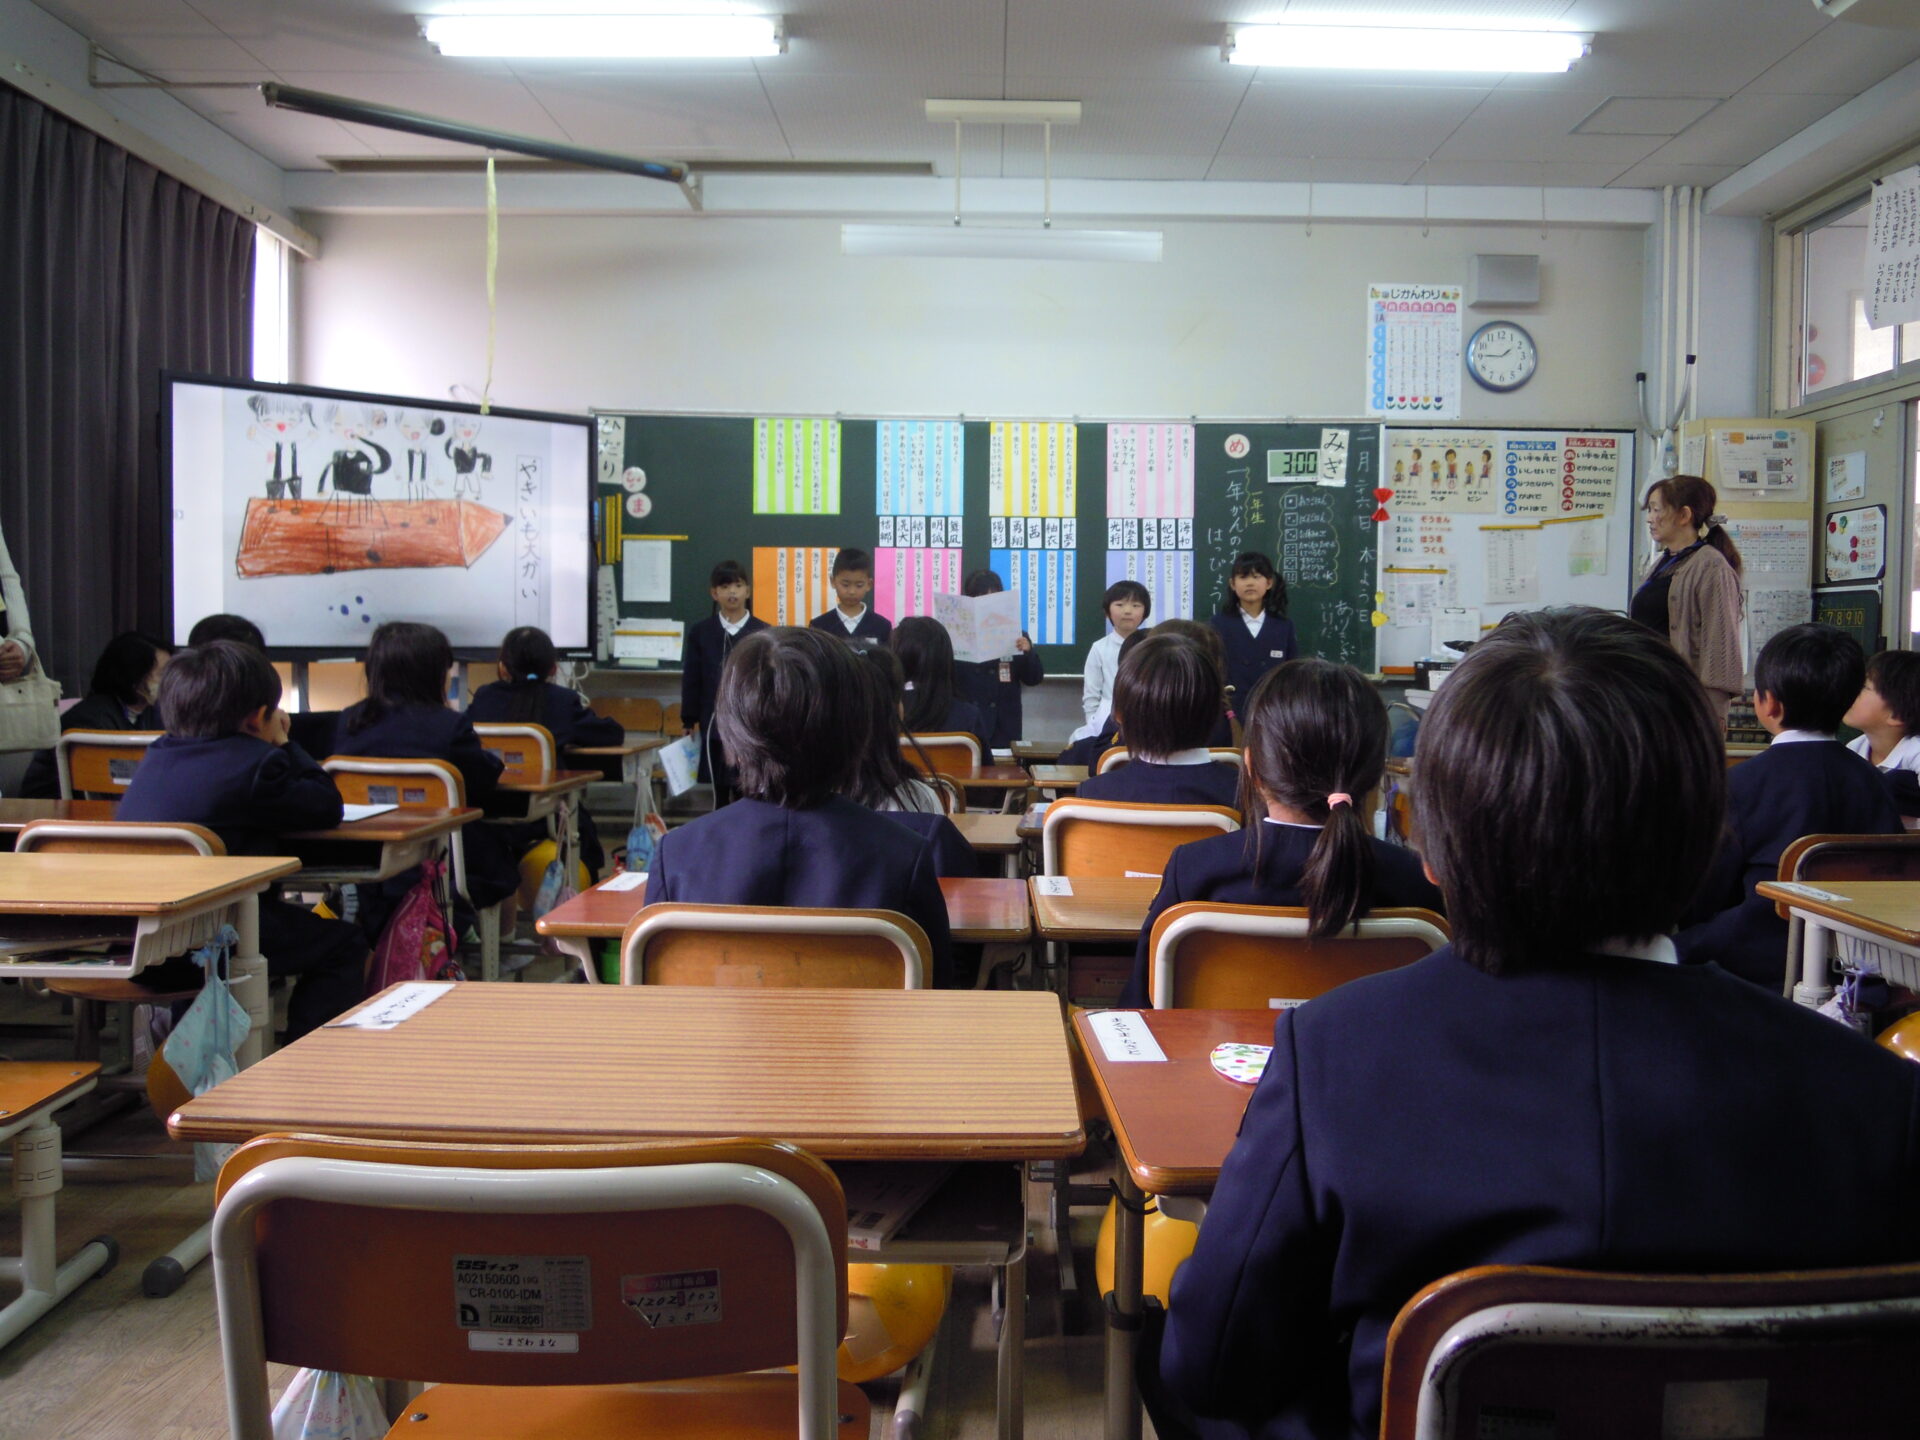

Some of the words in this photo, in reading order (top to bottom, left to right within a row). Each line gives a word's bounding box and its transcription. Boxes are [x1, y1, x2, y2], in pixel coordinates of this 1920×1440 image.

[1391, 289, 1440, 299] じかんわり
[1487, 333, 1494, 342] 11
[1497, 331, 1506, 339] 12
[1510, 333, 1514, 341] 1
[1479, 342, 1487, 351] 10
[1517, 341, 1522, 349] 2
[1478, 353, 1483, 361] 9
[1520, 352, 1526, 361] 3
[1517, 364, 1523, 372] 4
[1489, 371, 1494, 379] 7
[1499, 374, 1504, 382] 6
[1510, 371, 1515, 379] 5
[598, 419, 621, 479] ひだり
[1229, 438, 1246, 454] め
[1166, 437, 1174, 472] タブレット
[1324, 433, 1345, 479] みぎ
[1283, 451, 1318, 474] 3:00
[1423, 546, 1445, 554] つくえ
[1828, 611, 1834, 625] 7
[1836, 611, 1843, 625] 8
[1846, 611, 1852, 625] 9
[1855, 610, 1863, 625] 10
[469, 1288, 542, 1300] CR-0100-IDM
